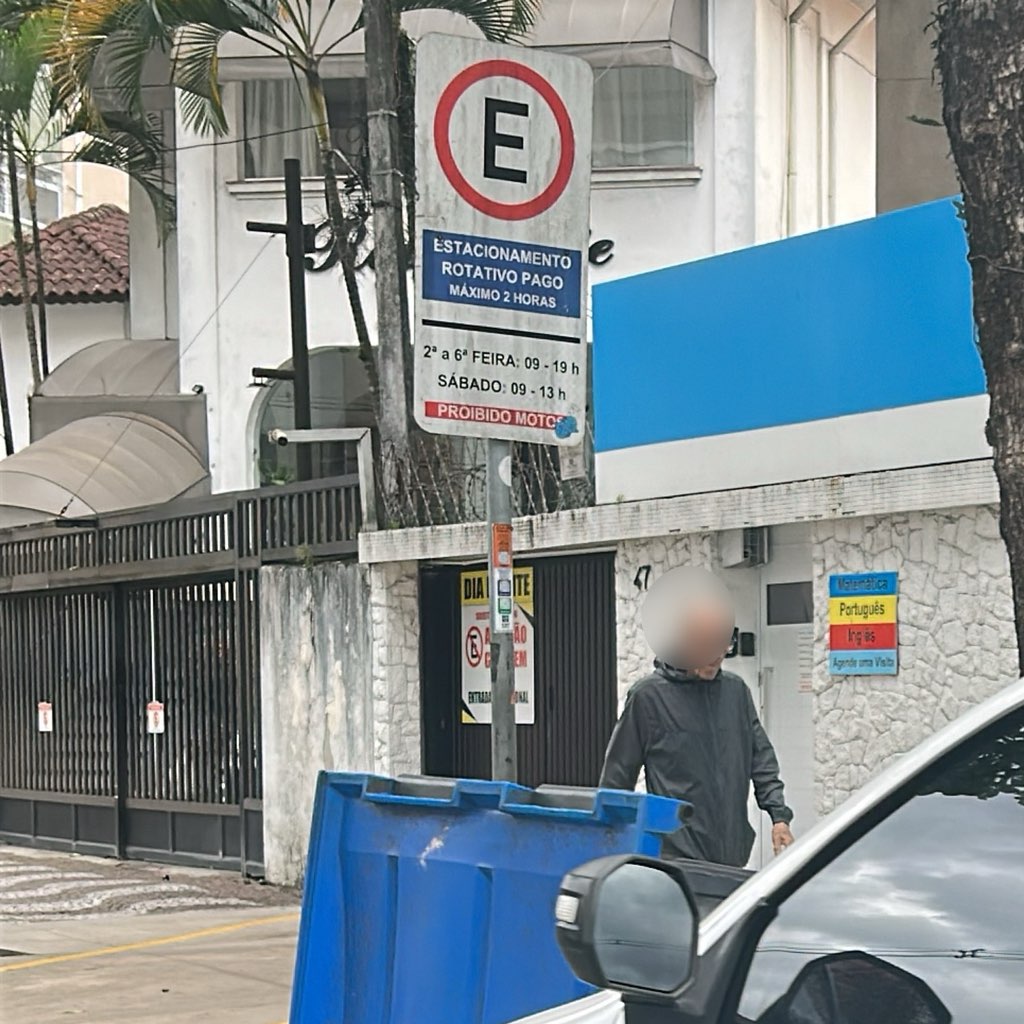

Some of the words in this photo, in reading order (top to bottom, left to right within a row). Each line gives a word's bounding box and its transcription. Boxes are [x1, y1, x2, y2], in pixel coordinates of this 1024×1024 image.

[484, 97, 528, 183] E
[433, 238, 571, 269] ESTACIONAMENTO
[441, 261, 517, 284] ROTATIVO
[521, 273, 563, 290] PAGO
[449, 283, 500, 301] MÁXIMO
[503, 291, 510, 302] 2
[513, 293, 556, 308] HORAS
[424, 345, 437, 358] 2ª
[441, 350, 449, 360] a
[454, 348, 467, 361] 6ª
[472, 350, 520, 368] FEIRA:
[524, 356, 540, 370] 09
[553, 360, 567, 374] 19
[572, 362, 580, 375] h
[438, 373, 506, 393] SÁBADO:
[511, 382, 526, 396] 09
[540, 386, 554, 399] 13
[559, 387, 566, 400] h
[437, 405, 511, 423] PROIBIDO
[464, 576, 484, 600] DIA
[839, 600, 885, 619] Português
